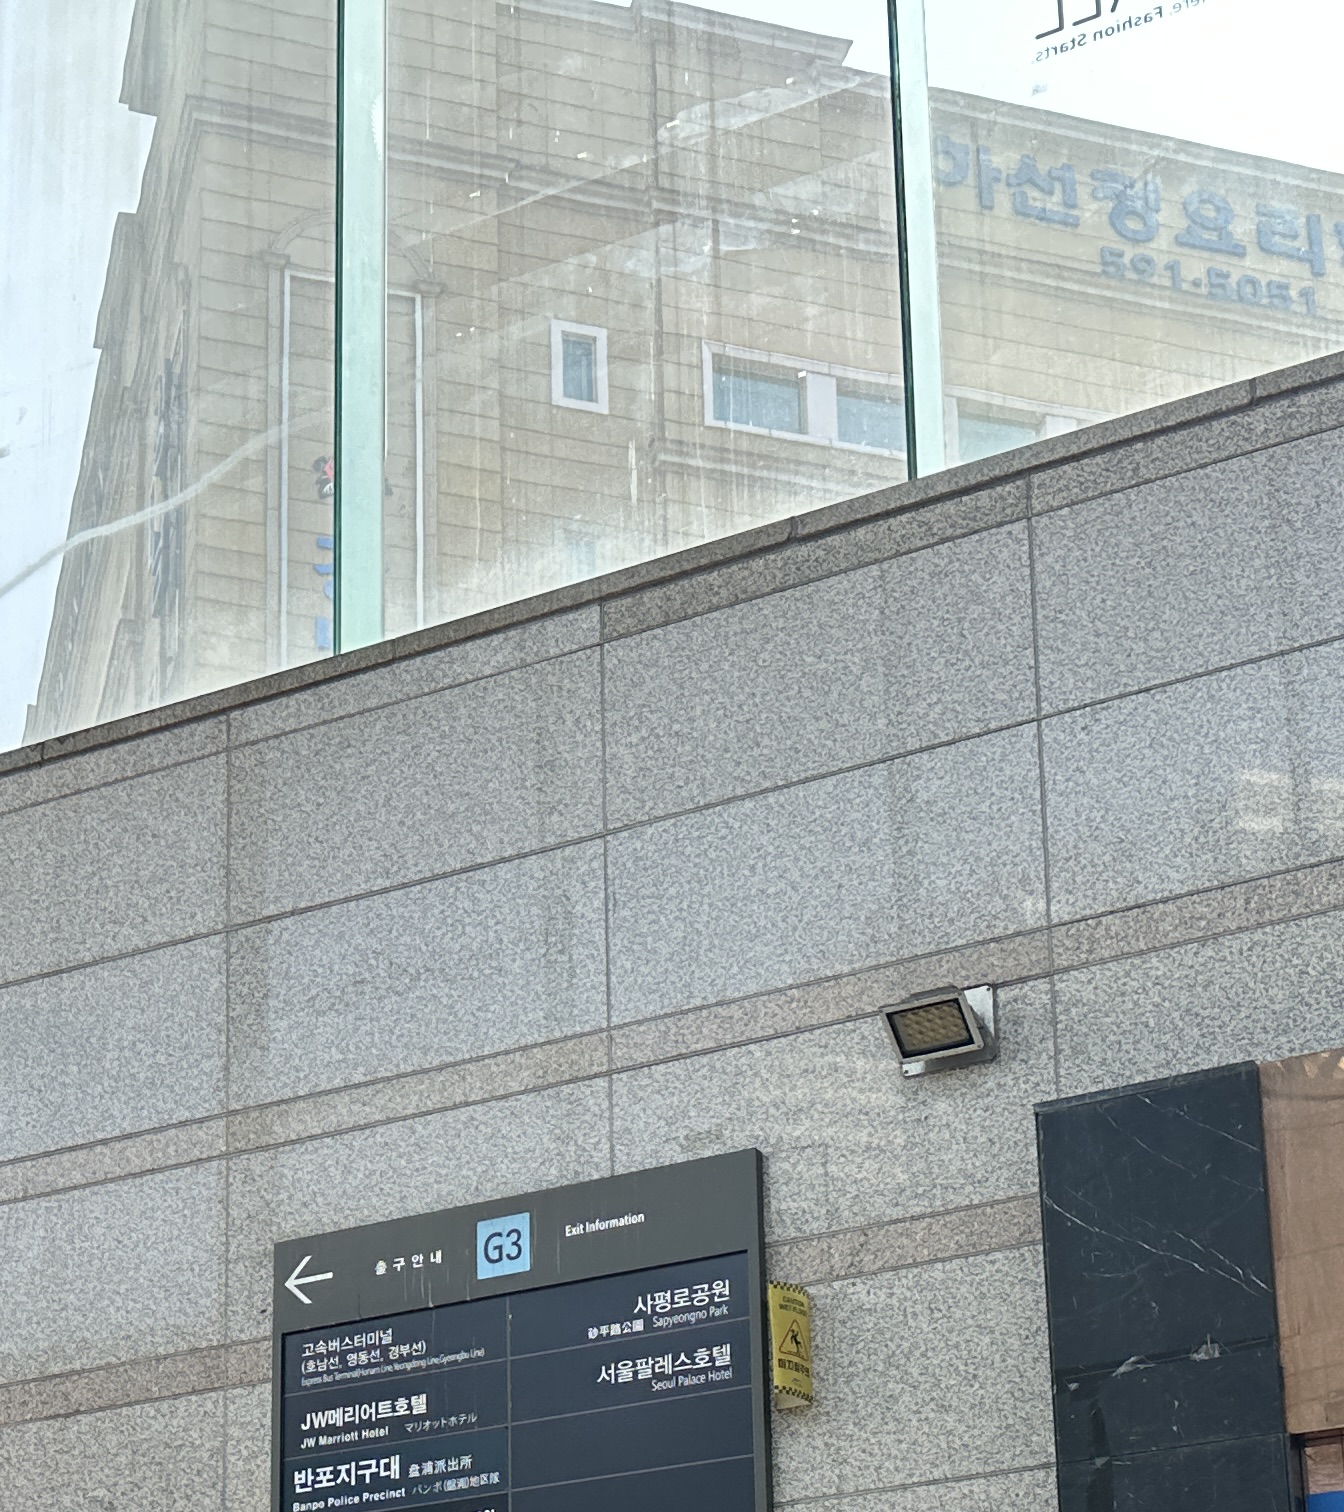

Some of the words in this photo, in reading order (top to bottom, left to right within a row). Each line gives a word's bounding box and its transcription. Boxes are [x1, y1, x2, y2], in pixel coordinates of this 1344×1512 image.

[565, 1223, 585, 1238] Exit
[585, 1211, 645, 1234] Information
[483, 1228, 523, 1264] G3
[633, 1278, 731, 1316] 사평로공원
[652, 1308, 708, 1329] Sapyeongno
[709, 1303, 729, 1318] Park
[301, 1327, 394, 1358] 고속버스터미널
[596, 1342, 732, 1385] 서울팔레스호텔
[651, 1377, 677, 1393] Seoul
[677, 1373, 706, 1387] Palace
[708, 1368, 733, 1382] Hotel
[300, 1393, 428, 1431] JW메리어트호텔
[300, 1437, 317, 1450] JW
[318, 1429, 359, 1448] Marriott
[361, 1425, 389, 1440] Hotel
[293, 1454, 401, 1494] 반포지구대
[292, 1500, 325, 1512] Banpo
[327, 1495, 360, 1508] Police
[362, 1487, 406, 1503] Precinct
